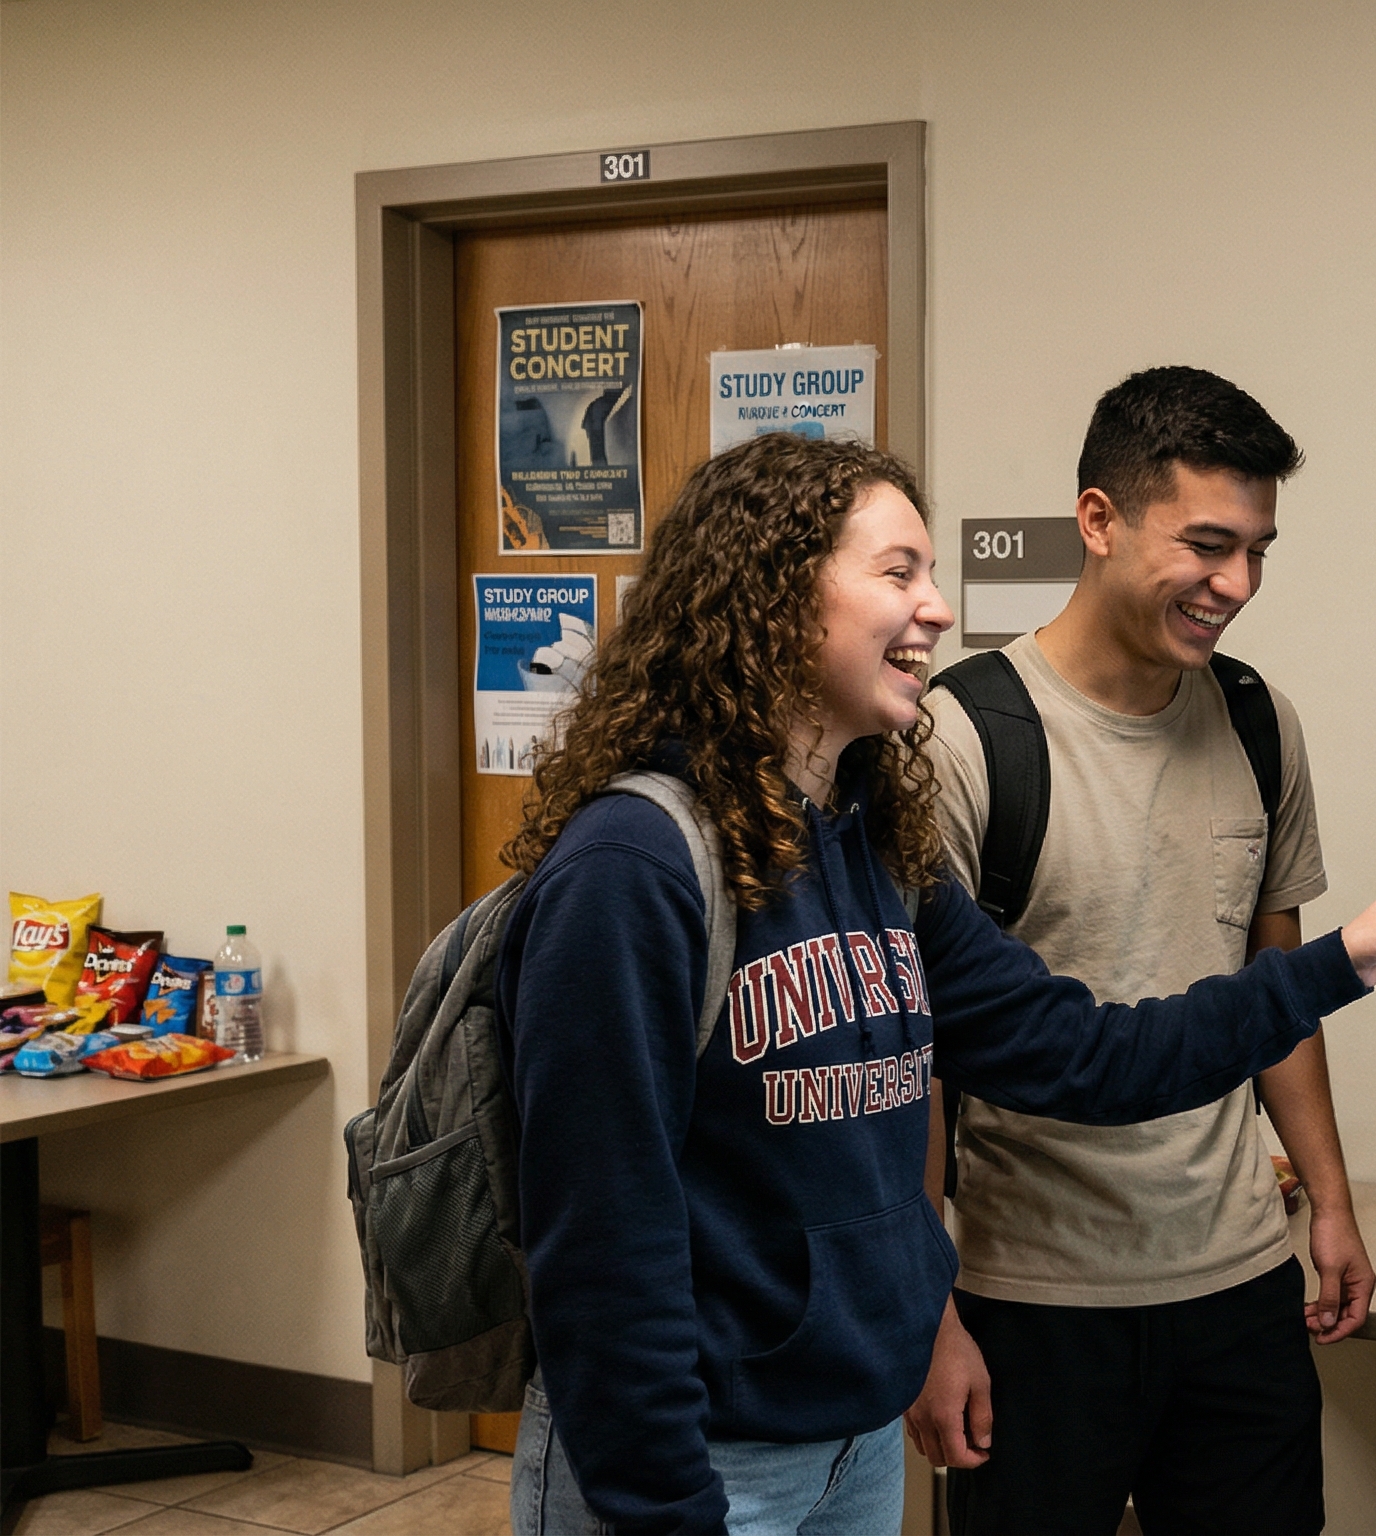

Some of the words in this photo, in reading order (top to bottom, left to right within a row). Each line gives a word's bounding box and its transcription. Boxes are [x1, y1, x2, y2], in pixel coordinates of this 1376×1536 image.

[604, 153, 645, 180] 301
[510, 324, 629, 353] STUDENT
[510, 352, 629, 380] CONCERT
[720, 372, 786, 398] STUDY
[792, 369, 864, 396] GROUP
[973, 530, 1024, 559] 301
[484, 588, 532, 604] STUDY
[537, 588, 589, 604] GROUP
